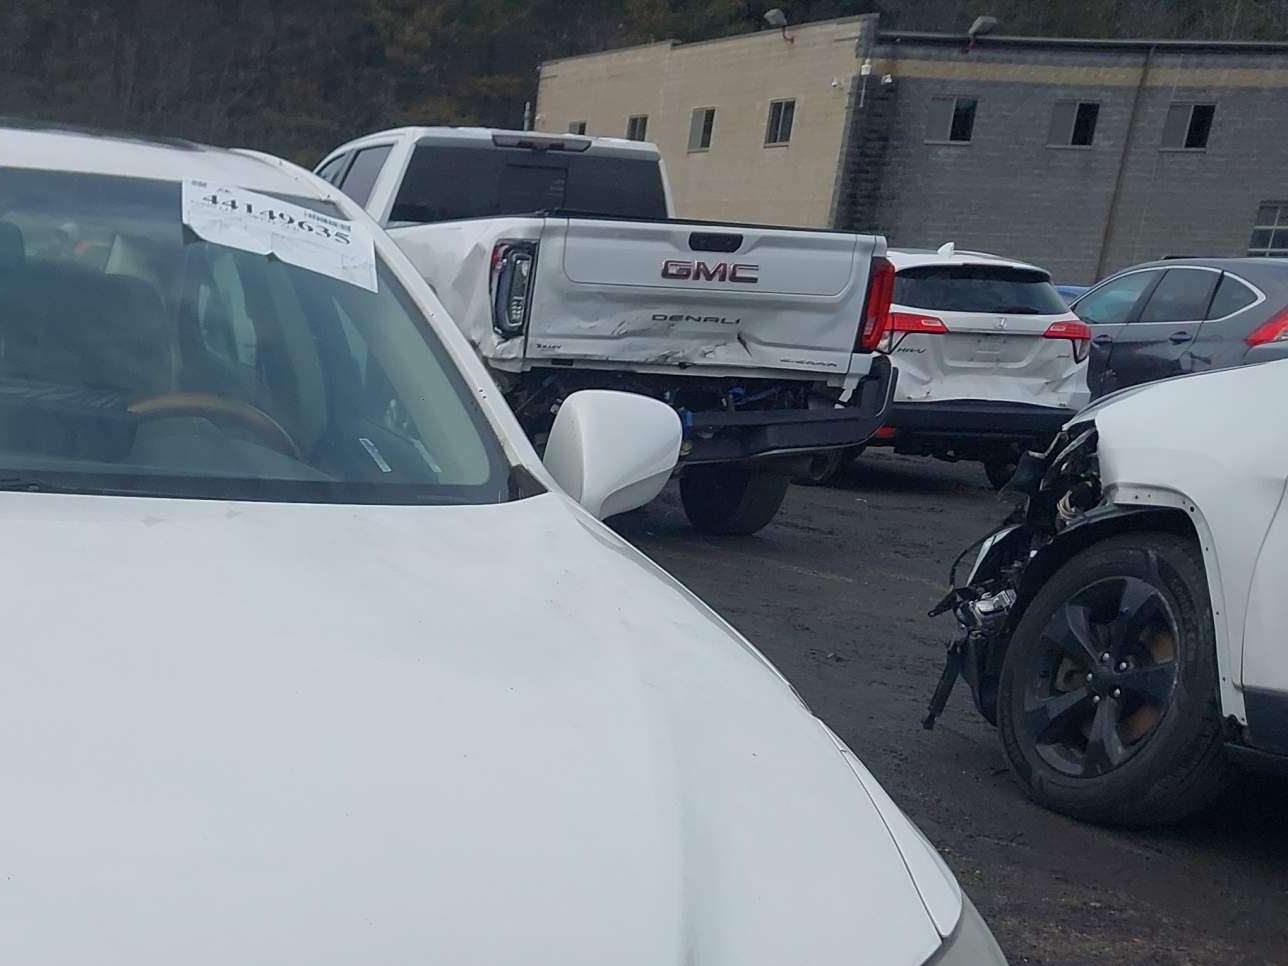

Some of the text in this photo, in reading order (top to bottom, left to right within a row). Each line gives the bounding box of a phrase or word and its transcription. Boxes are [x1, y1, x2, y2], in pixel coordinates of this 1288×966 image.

[202, 194, 351, 245] 44149635
[661, 260, 759, 283] GMC
[652, 314, 741, 325] DENALI
